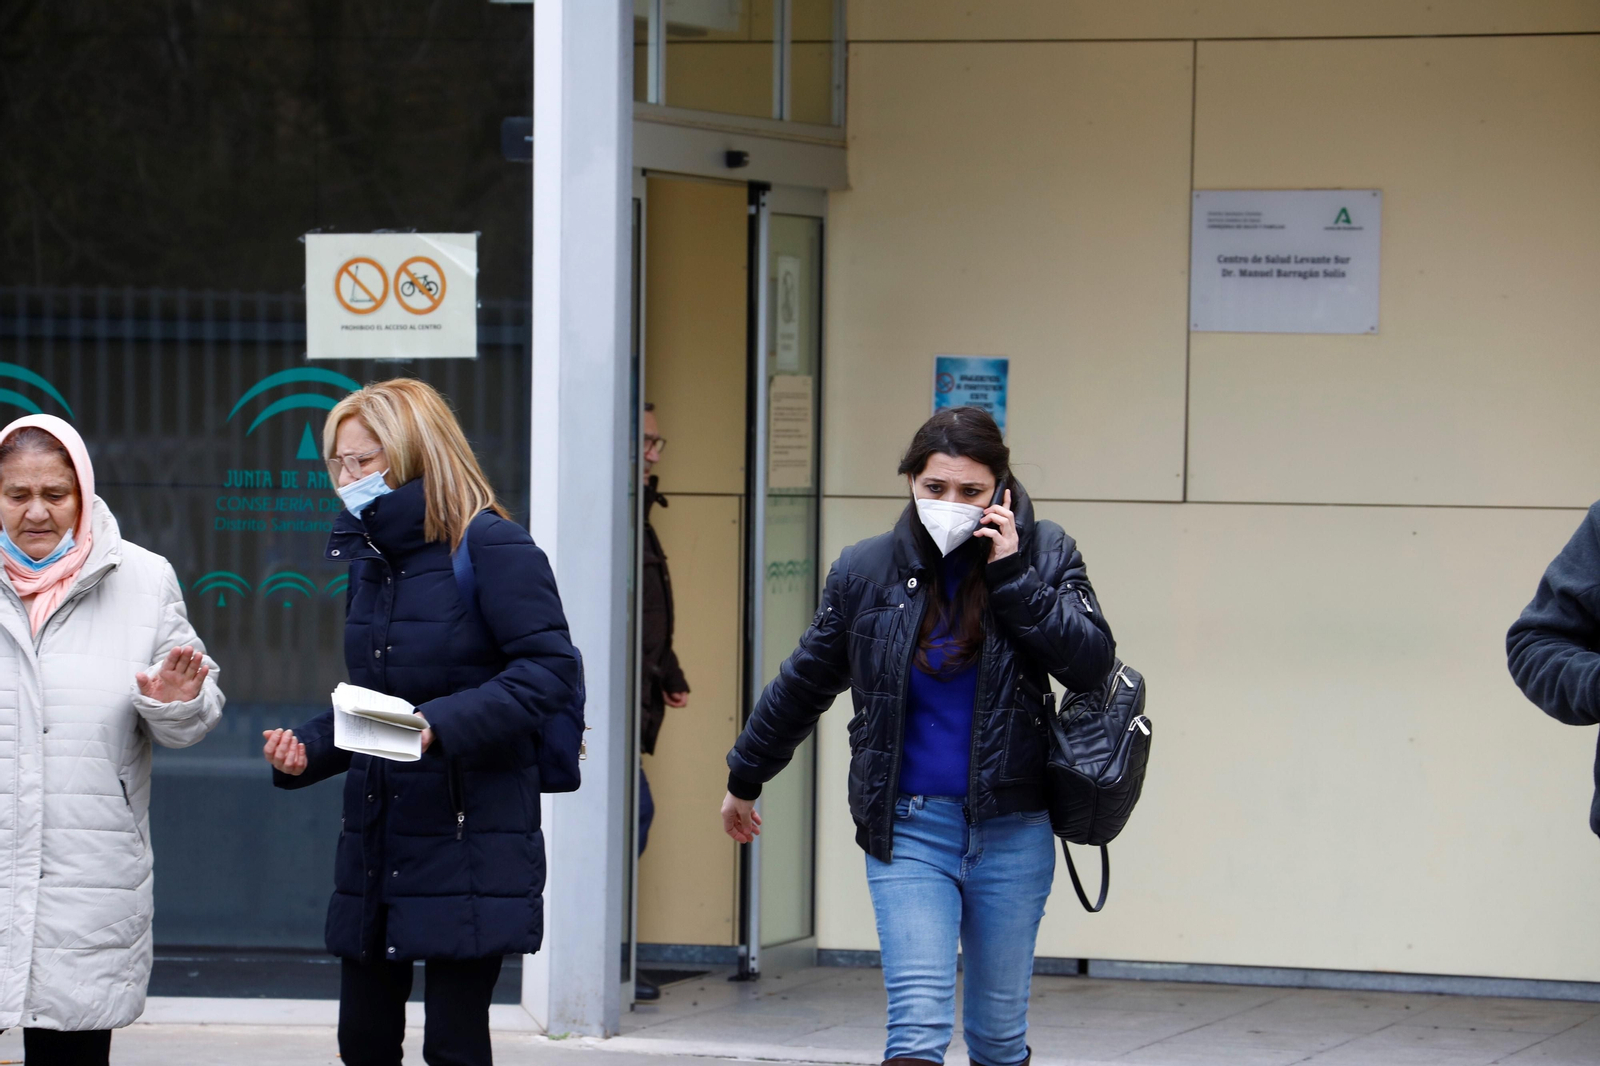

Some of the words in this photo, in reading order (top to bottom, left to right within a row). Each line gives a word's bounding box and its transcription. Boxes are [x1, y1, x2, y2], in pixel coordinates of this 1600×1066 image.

[1217, 254, 1249, 264] Centro
[1251, 254, 1262, 264] de
[1265, 254, 1291, 264] Salud
[1294, 254, 1331, 264] Levante
[1334, 254, 1350, 264] Sur
[1221, 268, 1236, 277] Dr.
[1239, 268, 1273, 277] Manuel
[223, 470, 273, 488] JUNTA
[281, 470, 299, 489] DE
[216, 494, 314, 512] CONSEJERÍA
[319, 498, 340, 512] DE
[214, 516, 267, 531] Distrito
[271, 517, 333, 532] Sanitario
